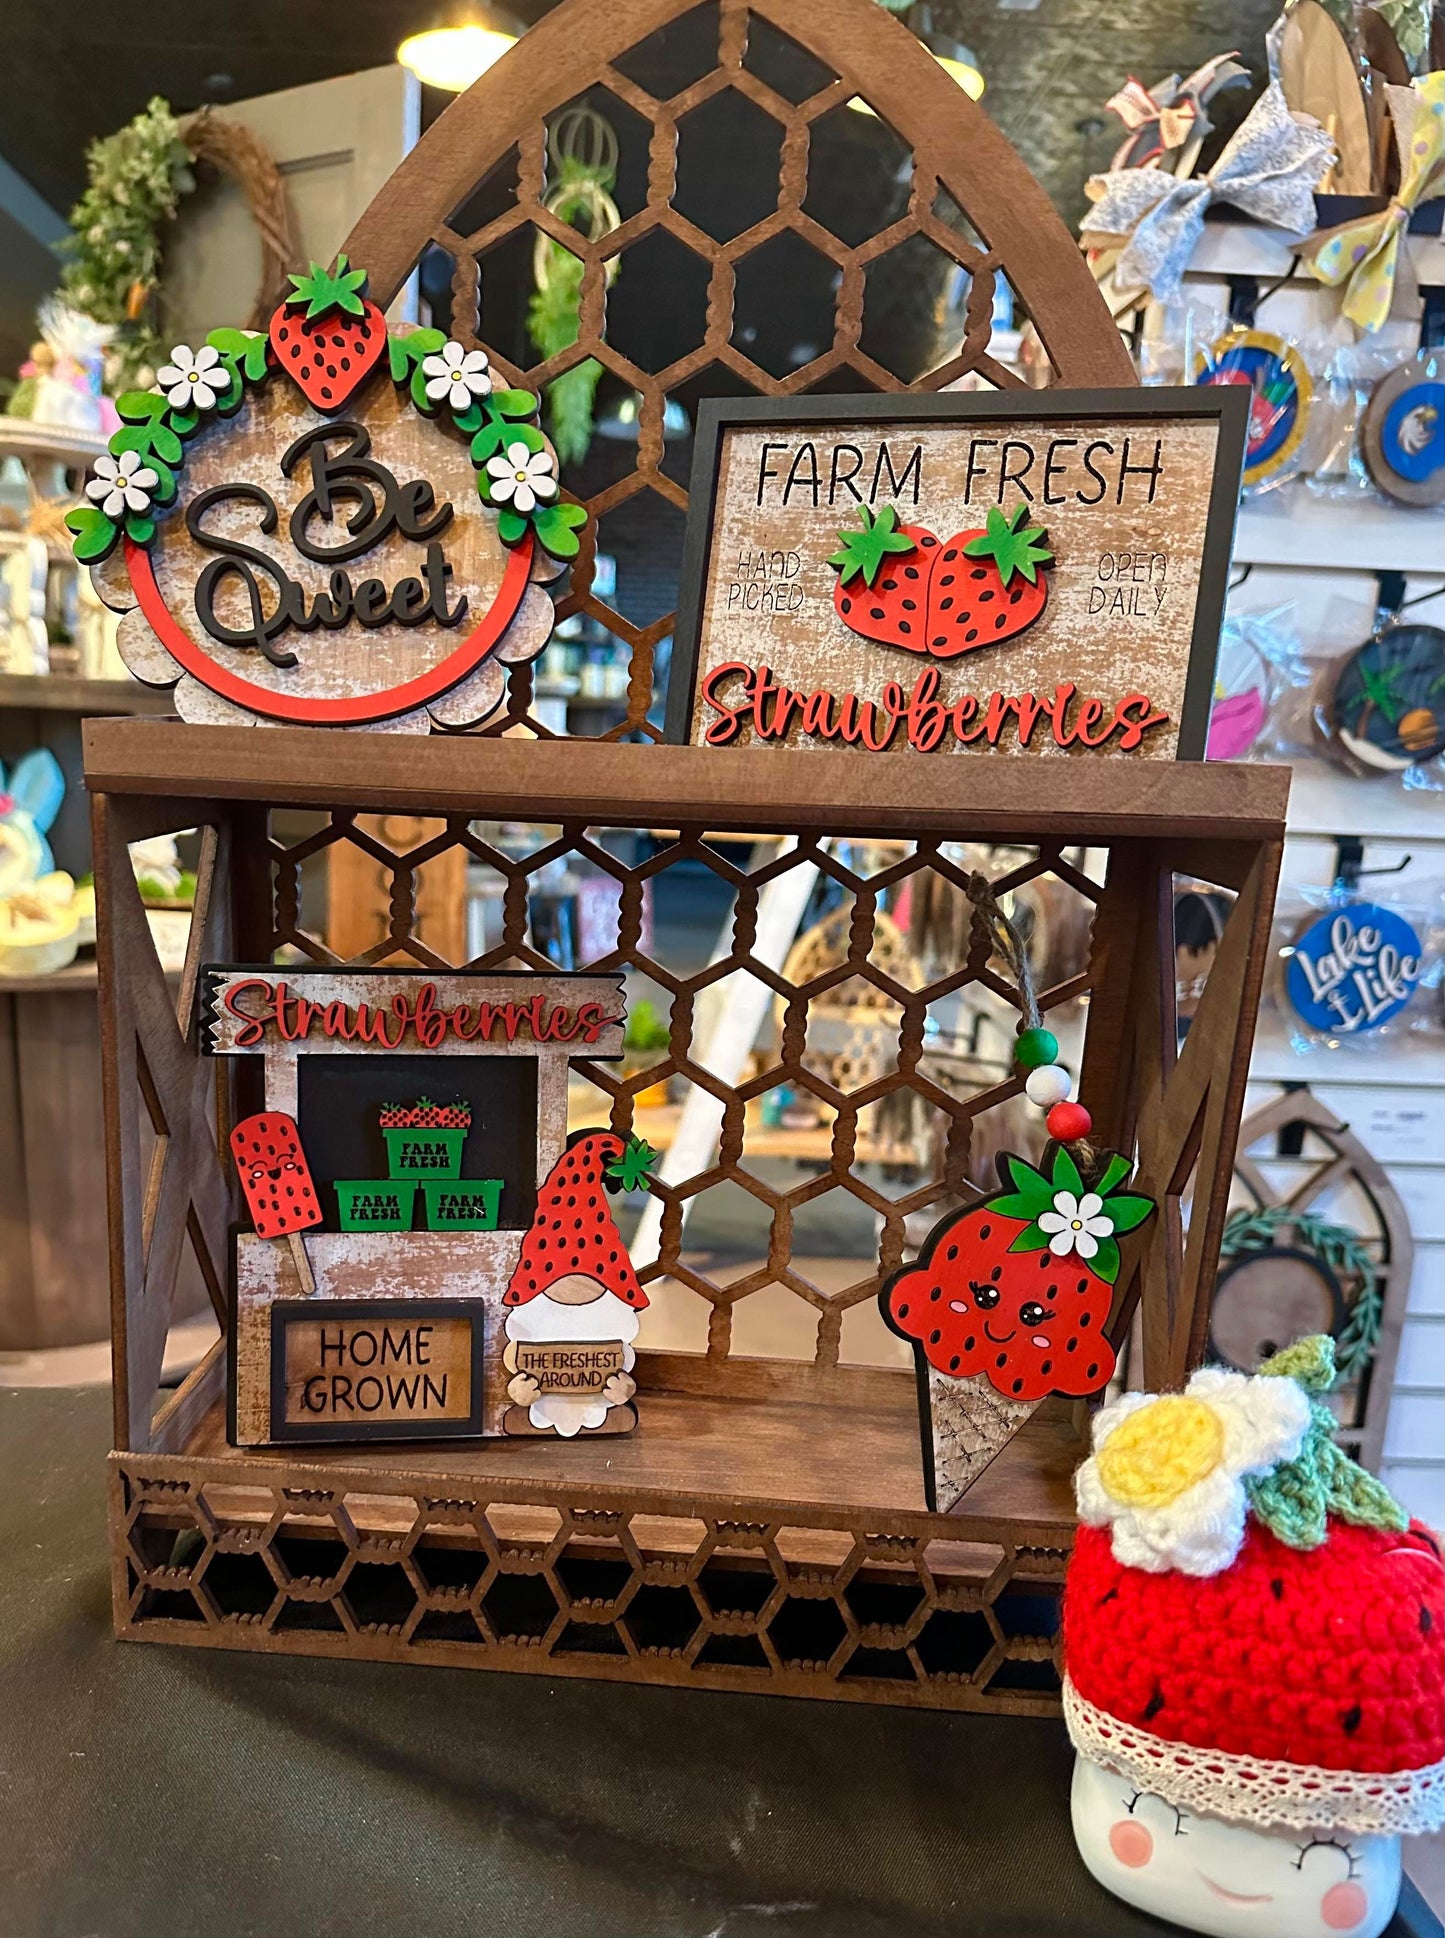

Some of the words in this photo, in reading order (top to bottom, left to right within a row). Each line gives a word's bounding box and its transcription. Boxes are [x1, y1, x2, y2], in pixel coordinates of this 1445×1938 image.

[757, 441, 922, 507] FARM
[963, 437, 1164, 505] FRESH
[281, 421, 454, 564] Be
[185, 482, 469, 669] Sweet
[737, 551, 801, 579] HAND
[1097, 553, 1168, 582] OPEN
[727, 583, 804, 611] PICKED
[1088, 586, 1168, 616] DAILY
[700, 661, 1169, 753] Strawberries
[1296, 914, 1382, 1004] Lake
[1352, 944, 1419, 1024] Life
[224, 978, 618, 1049] Strawberries
[399, 1156, 451, 1168] FRESH
[401, 1142, 448, 1155] FARM
[350, 1207, 402, 1220] FRESH
[352, 1195, 399, 1207] FARM
[437, 1207, 488, 1219] FRESH
[439, 1194, 485, 1207] FARM
[320, 1326, 434, 1368] HOME
[523, 1352, 549, 1369] THE
[553, 1351, 620, 1369] FRESHEST
[302, 1373, 448, 1413] GROWN
[540, 1370, 603, 1388] AROUND
